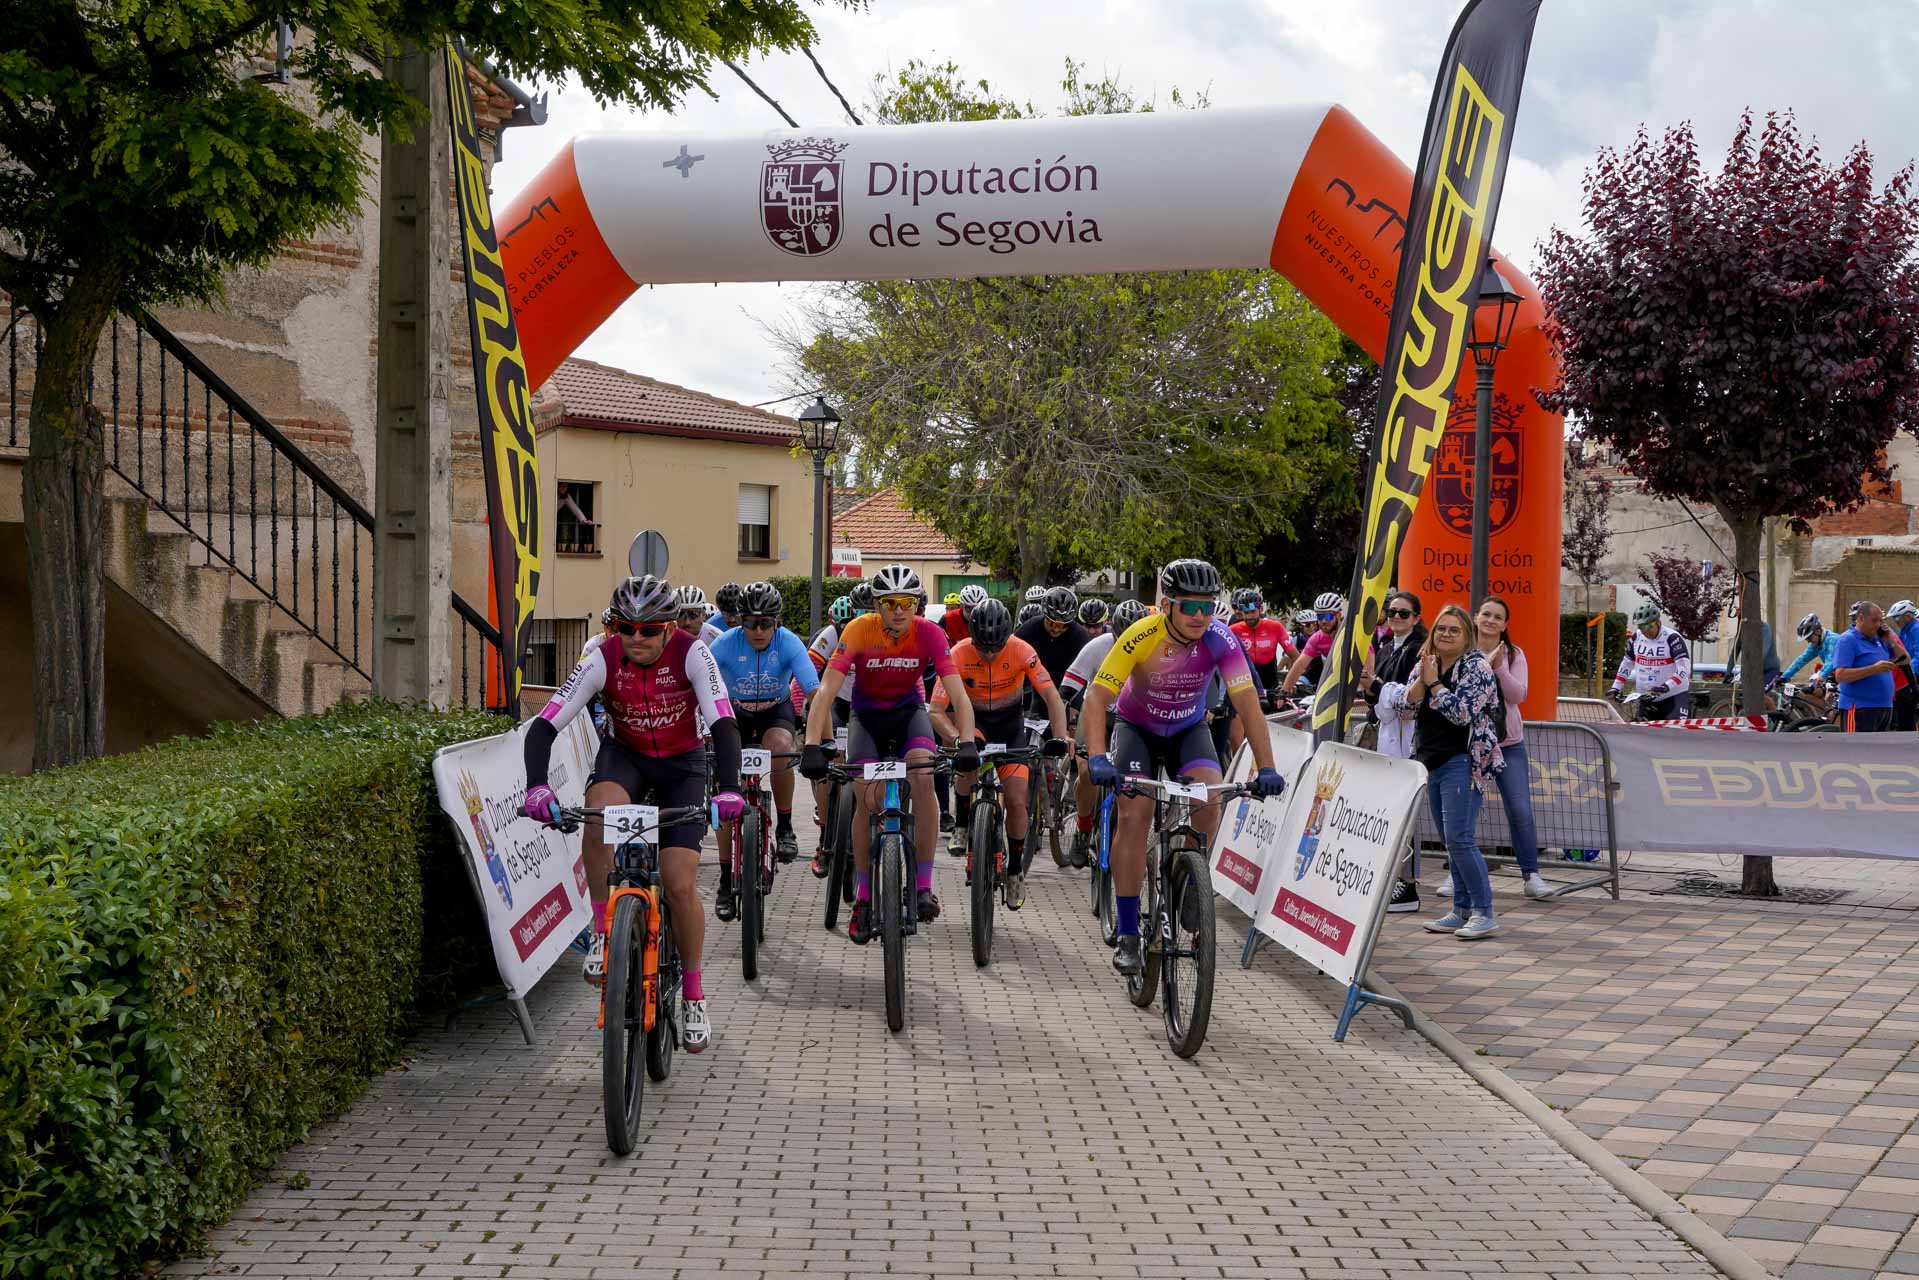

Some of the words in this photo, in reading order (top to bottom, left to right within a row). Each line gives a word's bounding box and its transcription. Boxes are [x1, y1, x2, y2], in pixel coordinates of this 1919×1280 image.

[867, 154, 1099, 205] Diputación
[868, 216, 919, 247] de
[935, 210, 1102, 254] Segovia
[1307, 209, 1379, 279] NUESTROS
[521, 249, 579, 305] FORTALEZA
[1304, 233, 1355, 283] NUESTRA
[1358, 283, 1392, 319] FORTA
[1423, 547, 1533, 570] Dipución
[1422, 574, 1444, 592] de
[1452, 574, 1533, 595] Seovia
[697, 646, 721, 696] Fontiveros
[866, 657, 920, 668] OLMEDO
[1637, 645, 1665, 656] UAE
[626, 701, 687, 716] Fontiveros
[743, 756, 762, 767] 20
[874, 761, 897, 773] 22
[485, 780, 528, 838] Diputació
[617, 816, 645, 833] 34
[1330, 795, 1390, 846] Diputación
[507, 848, 519, 883] de
[514, 830, 552, 878] Segovia
[1315, 843, 1332, 878] de
[1330, 848, 1374, 896] Segovia
[1283, 898, 1298, 920] Cultura,
[1297, 905, 1317, 929] Juventud
[1319, 916, 1341, 942] Deportes
